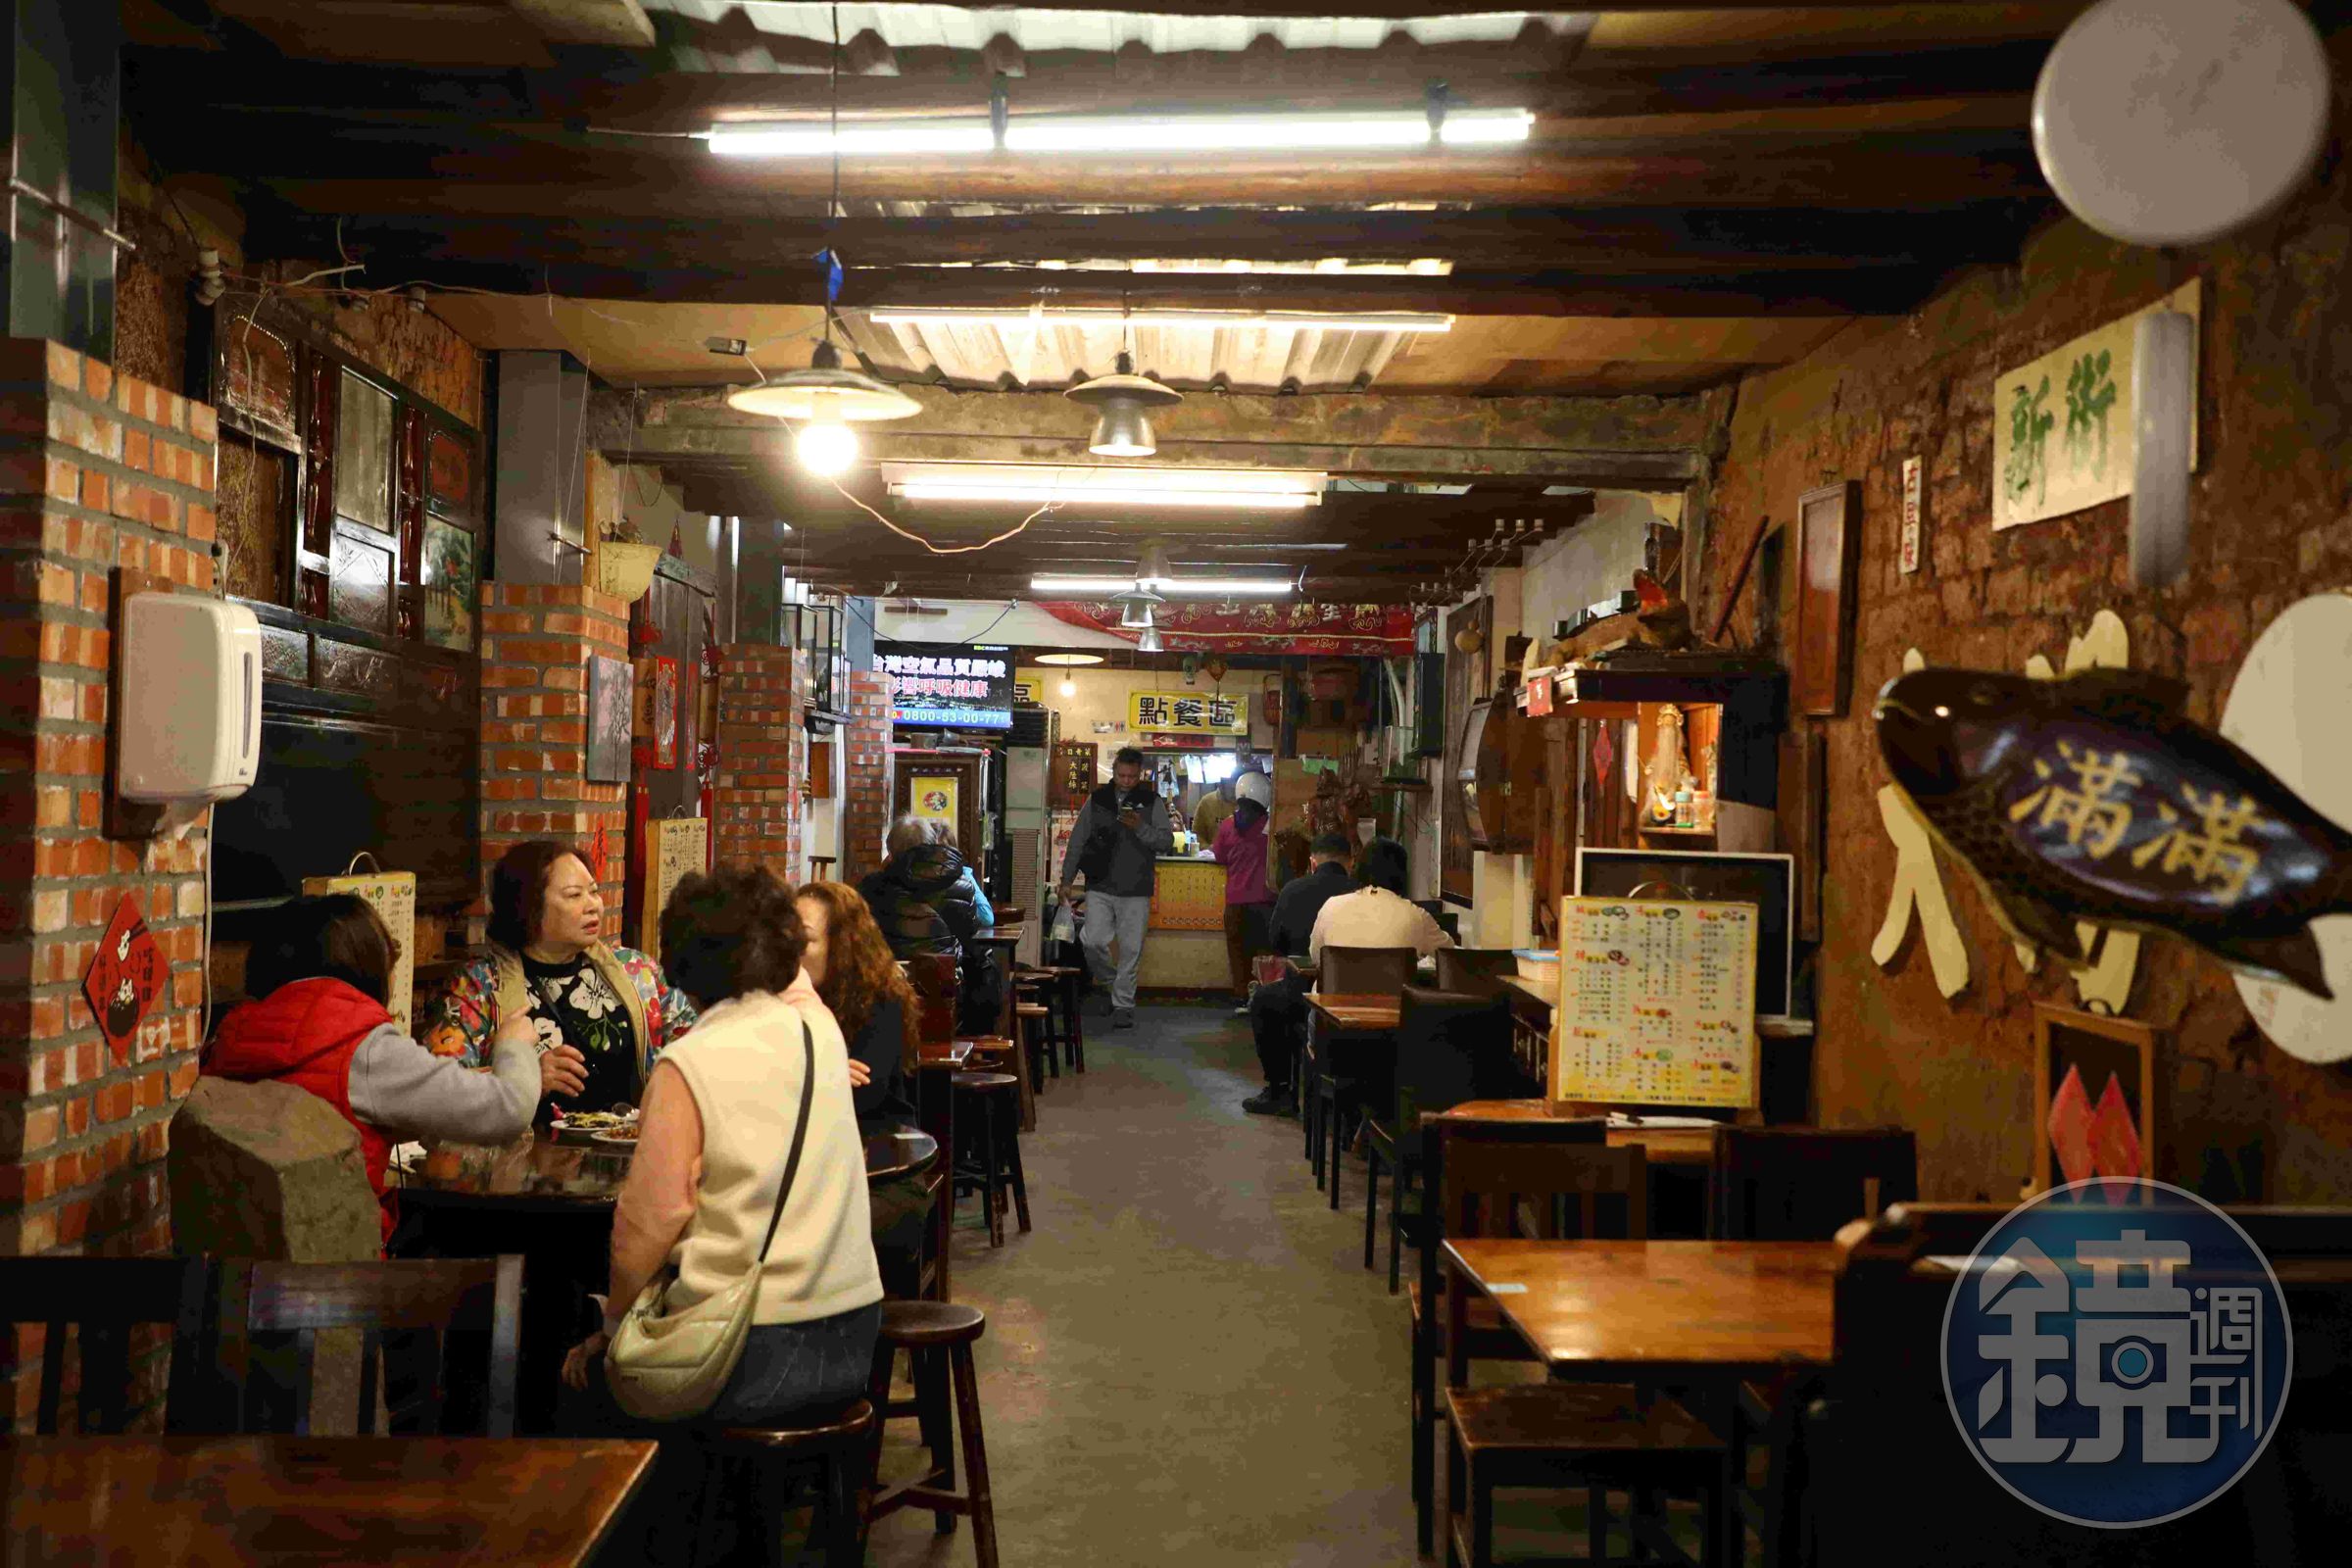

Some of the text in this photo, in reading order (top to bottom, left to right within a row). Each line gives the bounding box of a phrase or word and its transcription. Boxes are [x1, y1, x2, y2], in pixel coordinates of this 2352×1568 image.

[873, 653, 1006, 678] 台灣空氣品質嚴峻
[1139, 697, 1237, 727] 點餐區
[2008, 739, 2267, 906] 滿滿
